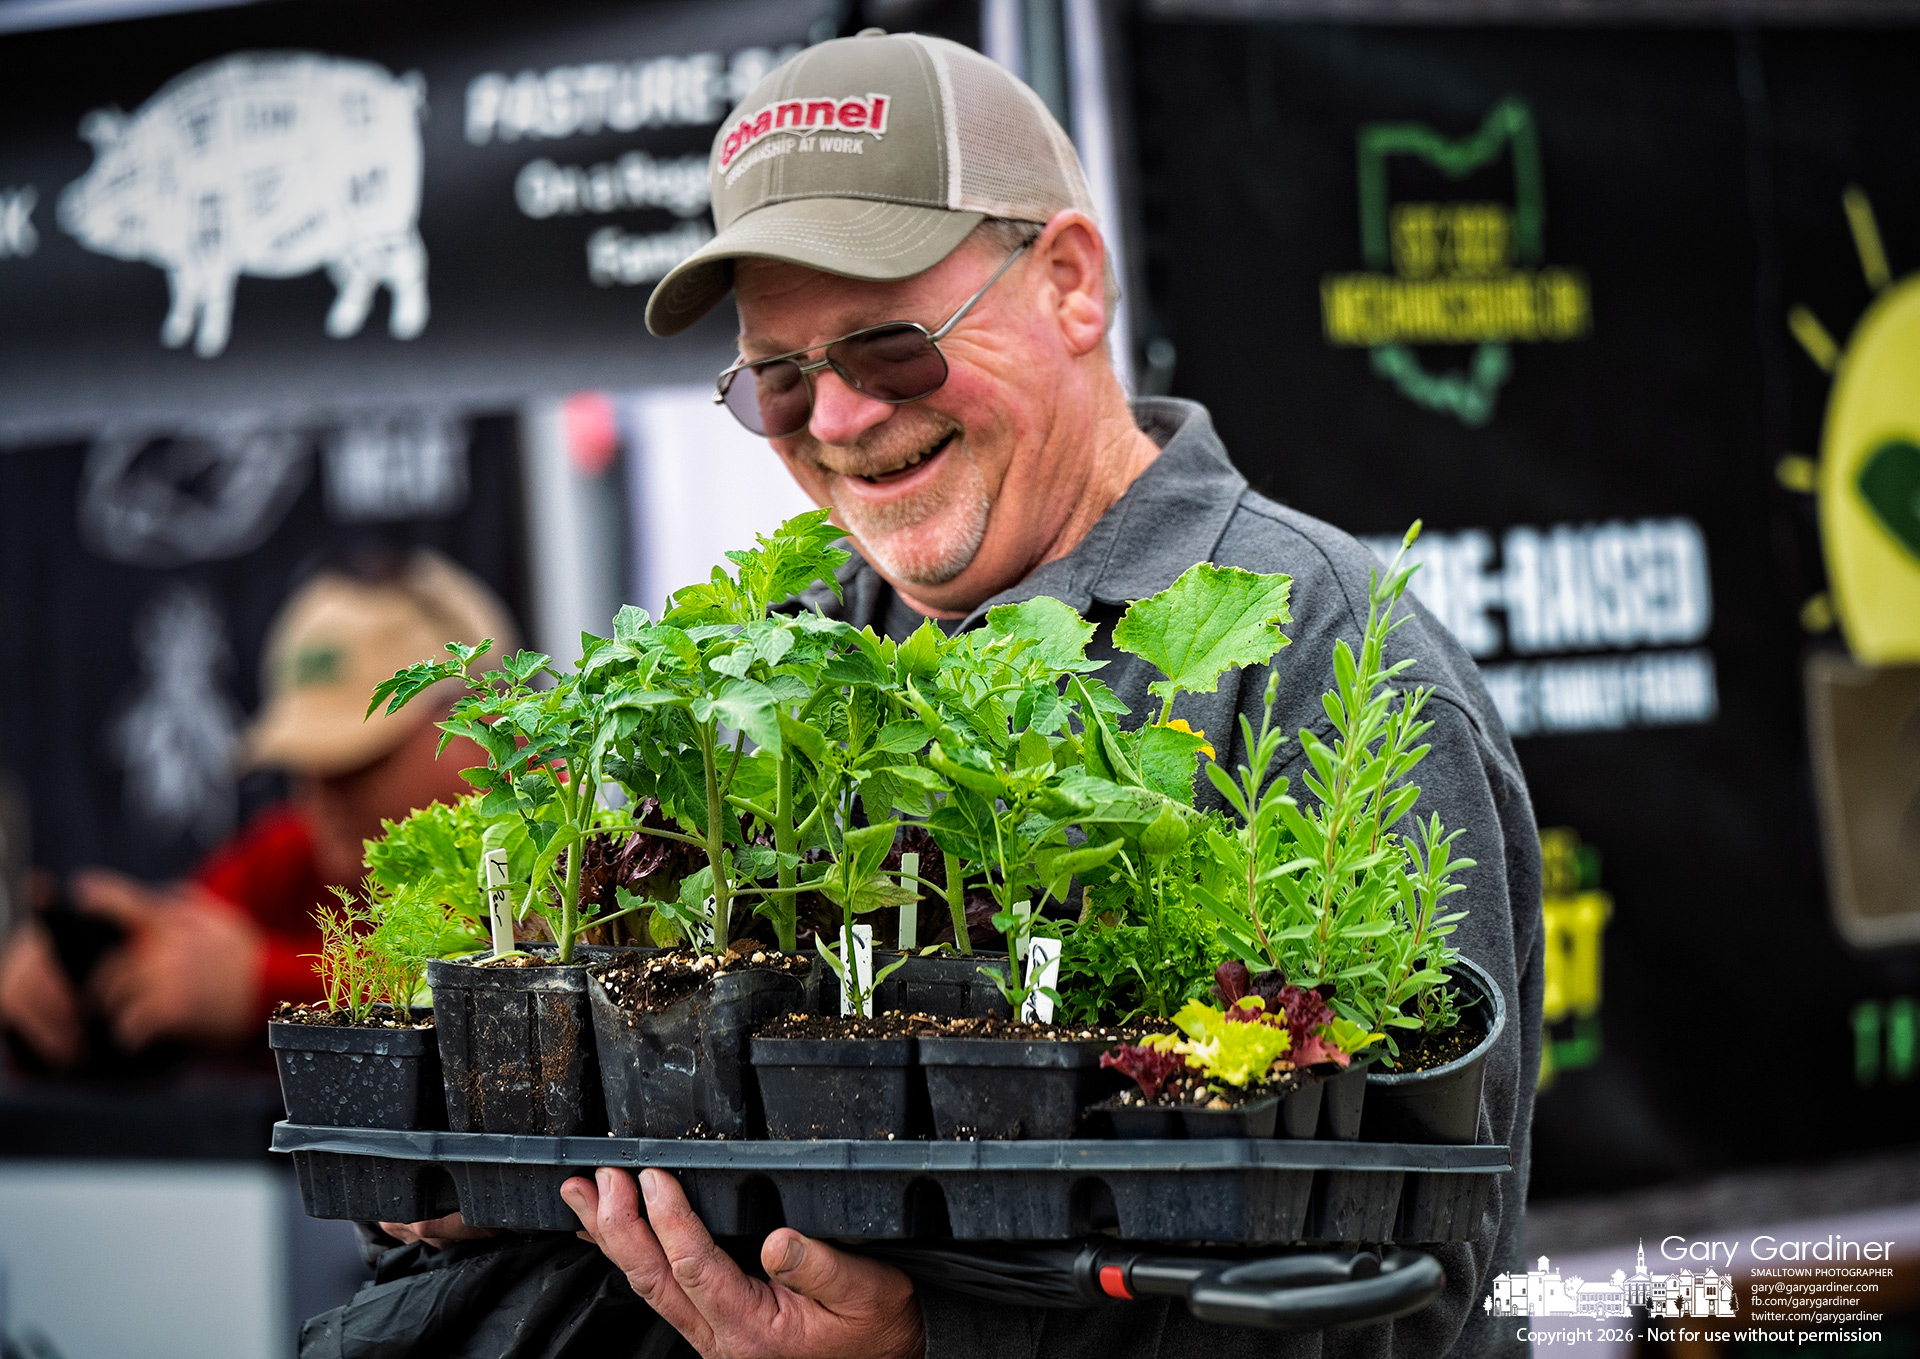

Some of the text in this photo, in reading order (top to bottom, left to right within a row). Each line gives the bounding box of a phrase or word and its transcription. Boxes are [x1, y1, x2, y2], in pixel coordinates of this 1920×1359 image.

[718, 95, 890, 173] Channel
[798, 138, 817, 153] AT
[819, 138, 864, 154] WORK
